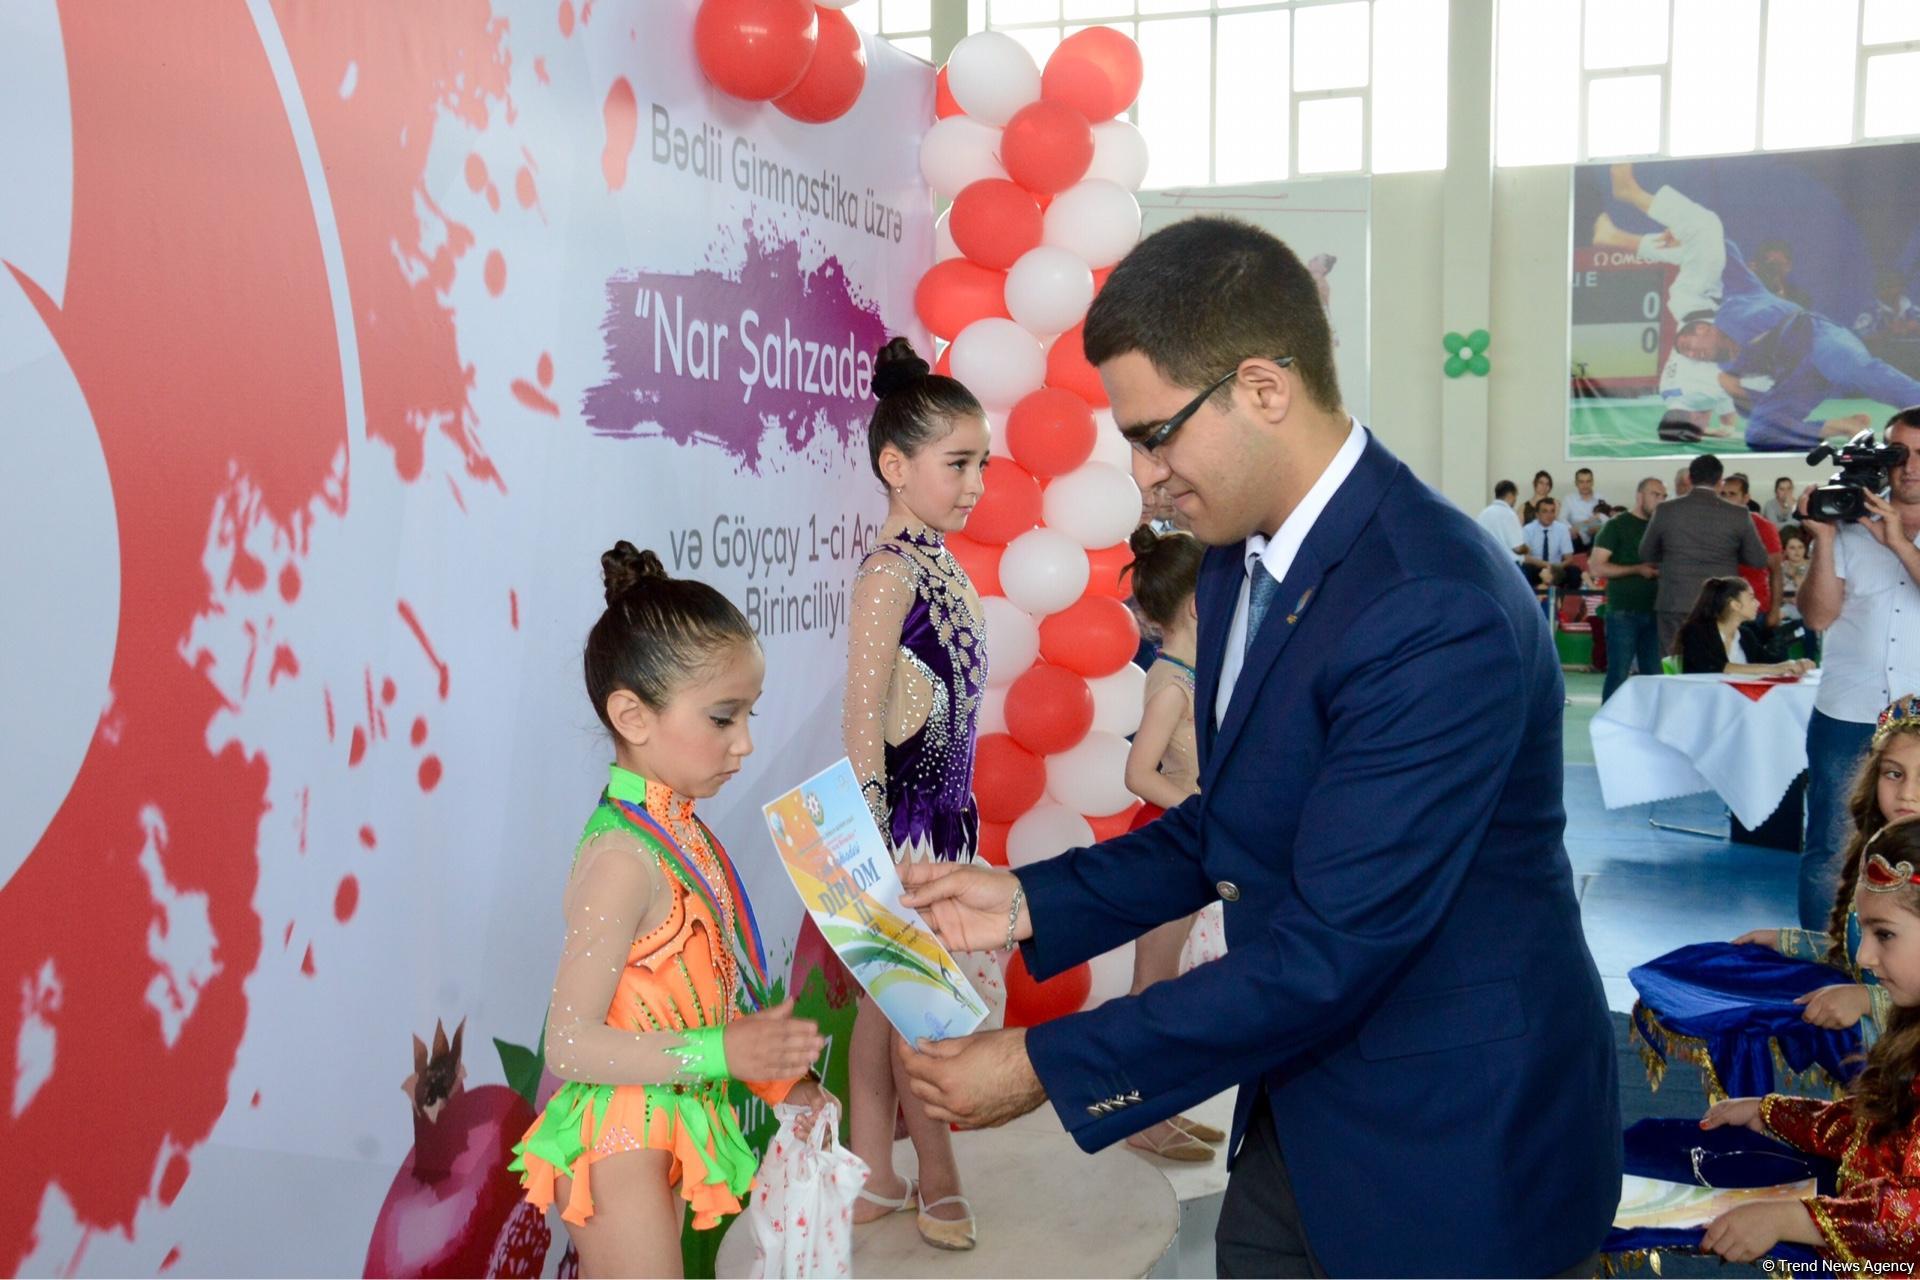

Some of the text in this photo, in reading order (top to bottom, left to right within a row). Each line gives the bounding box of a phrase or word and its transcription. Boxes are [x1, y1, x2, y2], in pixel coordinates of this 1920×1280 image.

[652, 102, 902, 243] Bədii Gimnastika üzrə
[1643, 291, 1660, 319] 0
[739, 309, 880, 404] Şahzadə
[1641, 327, 1658, 354] 0
[670, 529, 703, 571] və
[713, 514, 800, 580] Göyçay
[808, 512, 845, 562] 1-ci
[746, 579, 845, 639] Birinciliyi
